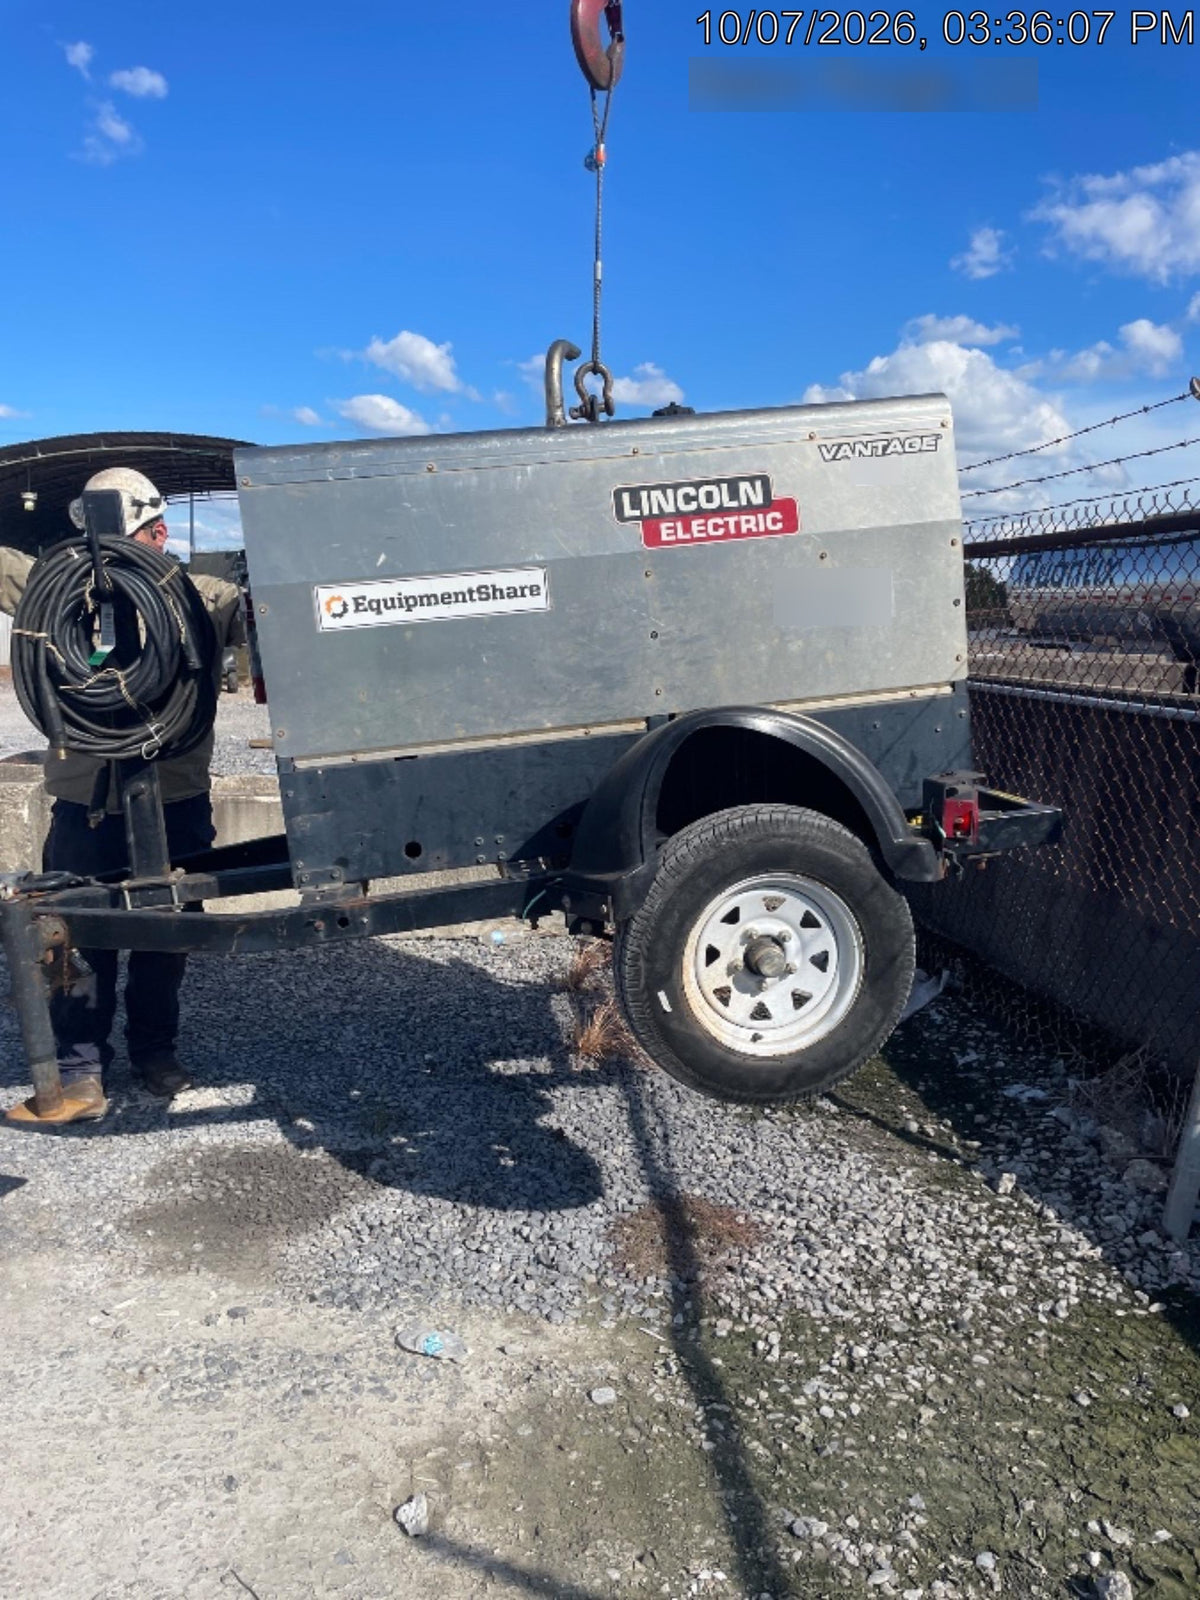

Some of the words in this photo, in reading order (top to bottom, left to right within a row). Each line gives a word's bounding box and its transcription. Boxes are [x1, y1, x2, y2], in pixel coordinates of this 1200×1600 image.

[819, 435, 939, 462] VANTAGE
[622, 479, 764, 517] LINCOLN
[660, 512, 783, 541] ELECTRIC
[352, 583, 541, 615] EquipmentShare
